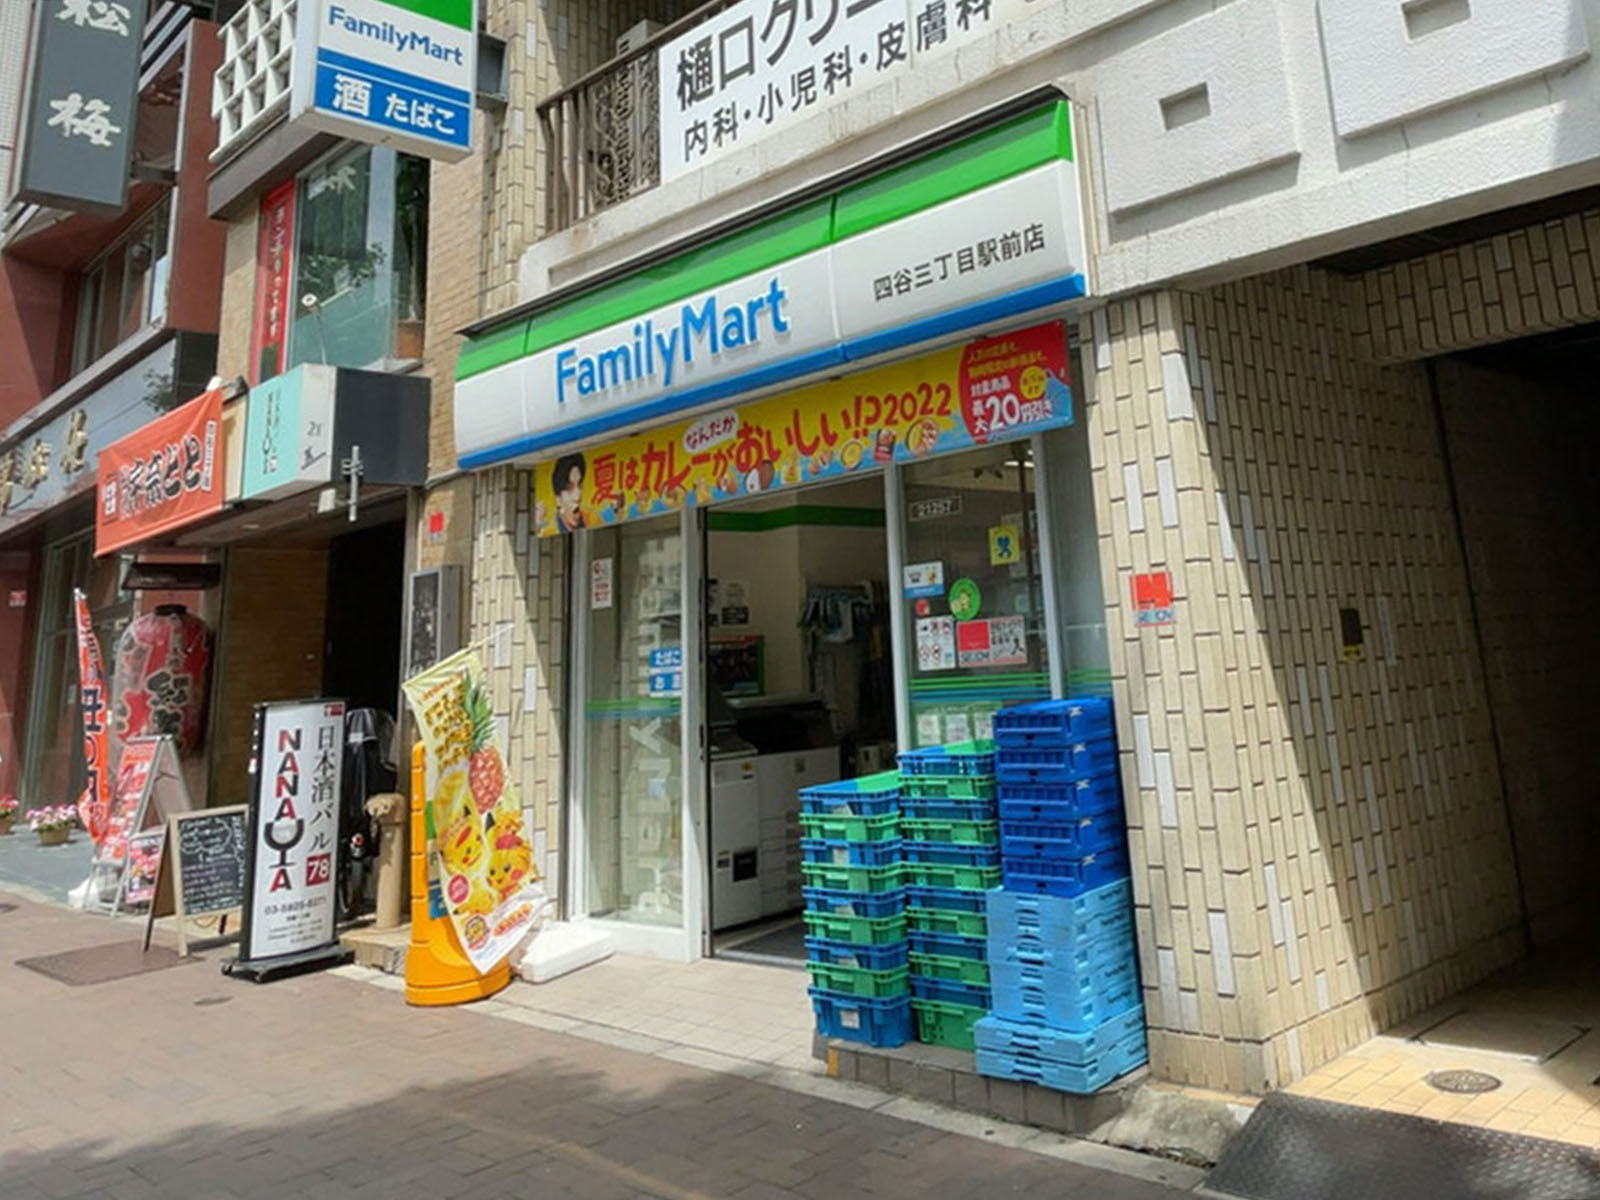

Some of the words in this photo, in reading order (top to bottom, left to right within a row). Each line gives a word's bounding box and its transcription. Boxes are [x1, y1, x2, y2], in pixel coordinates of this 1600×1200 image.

[328, 5, 464, 66] FamilyMart
[332, 73, 373, 117] 酒
[385, 92, 456, 135] たばこ
[873, 224, 1046, 302] 四谷三丁目駅前店
[556, 277, 790, 403] FamilyMart
[311, 725, 337, 853] 日本酒バル
[307, 858, 330, 882] 78
